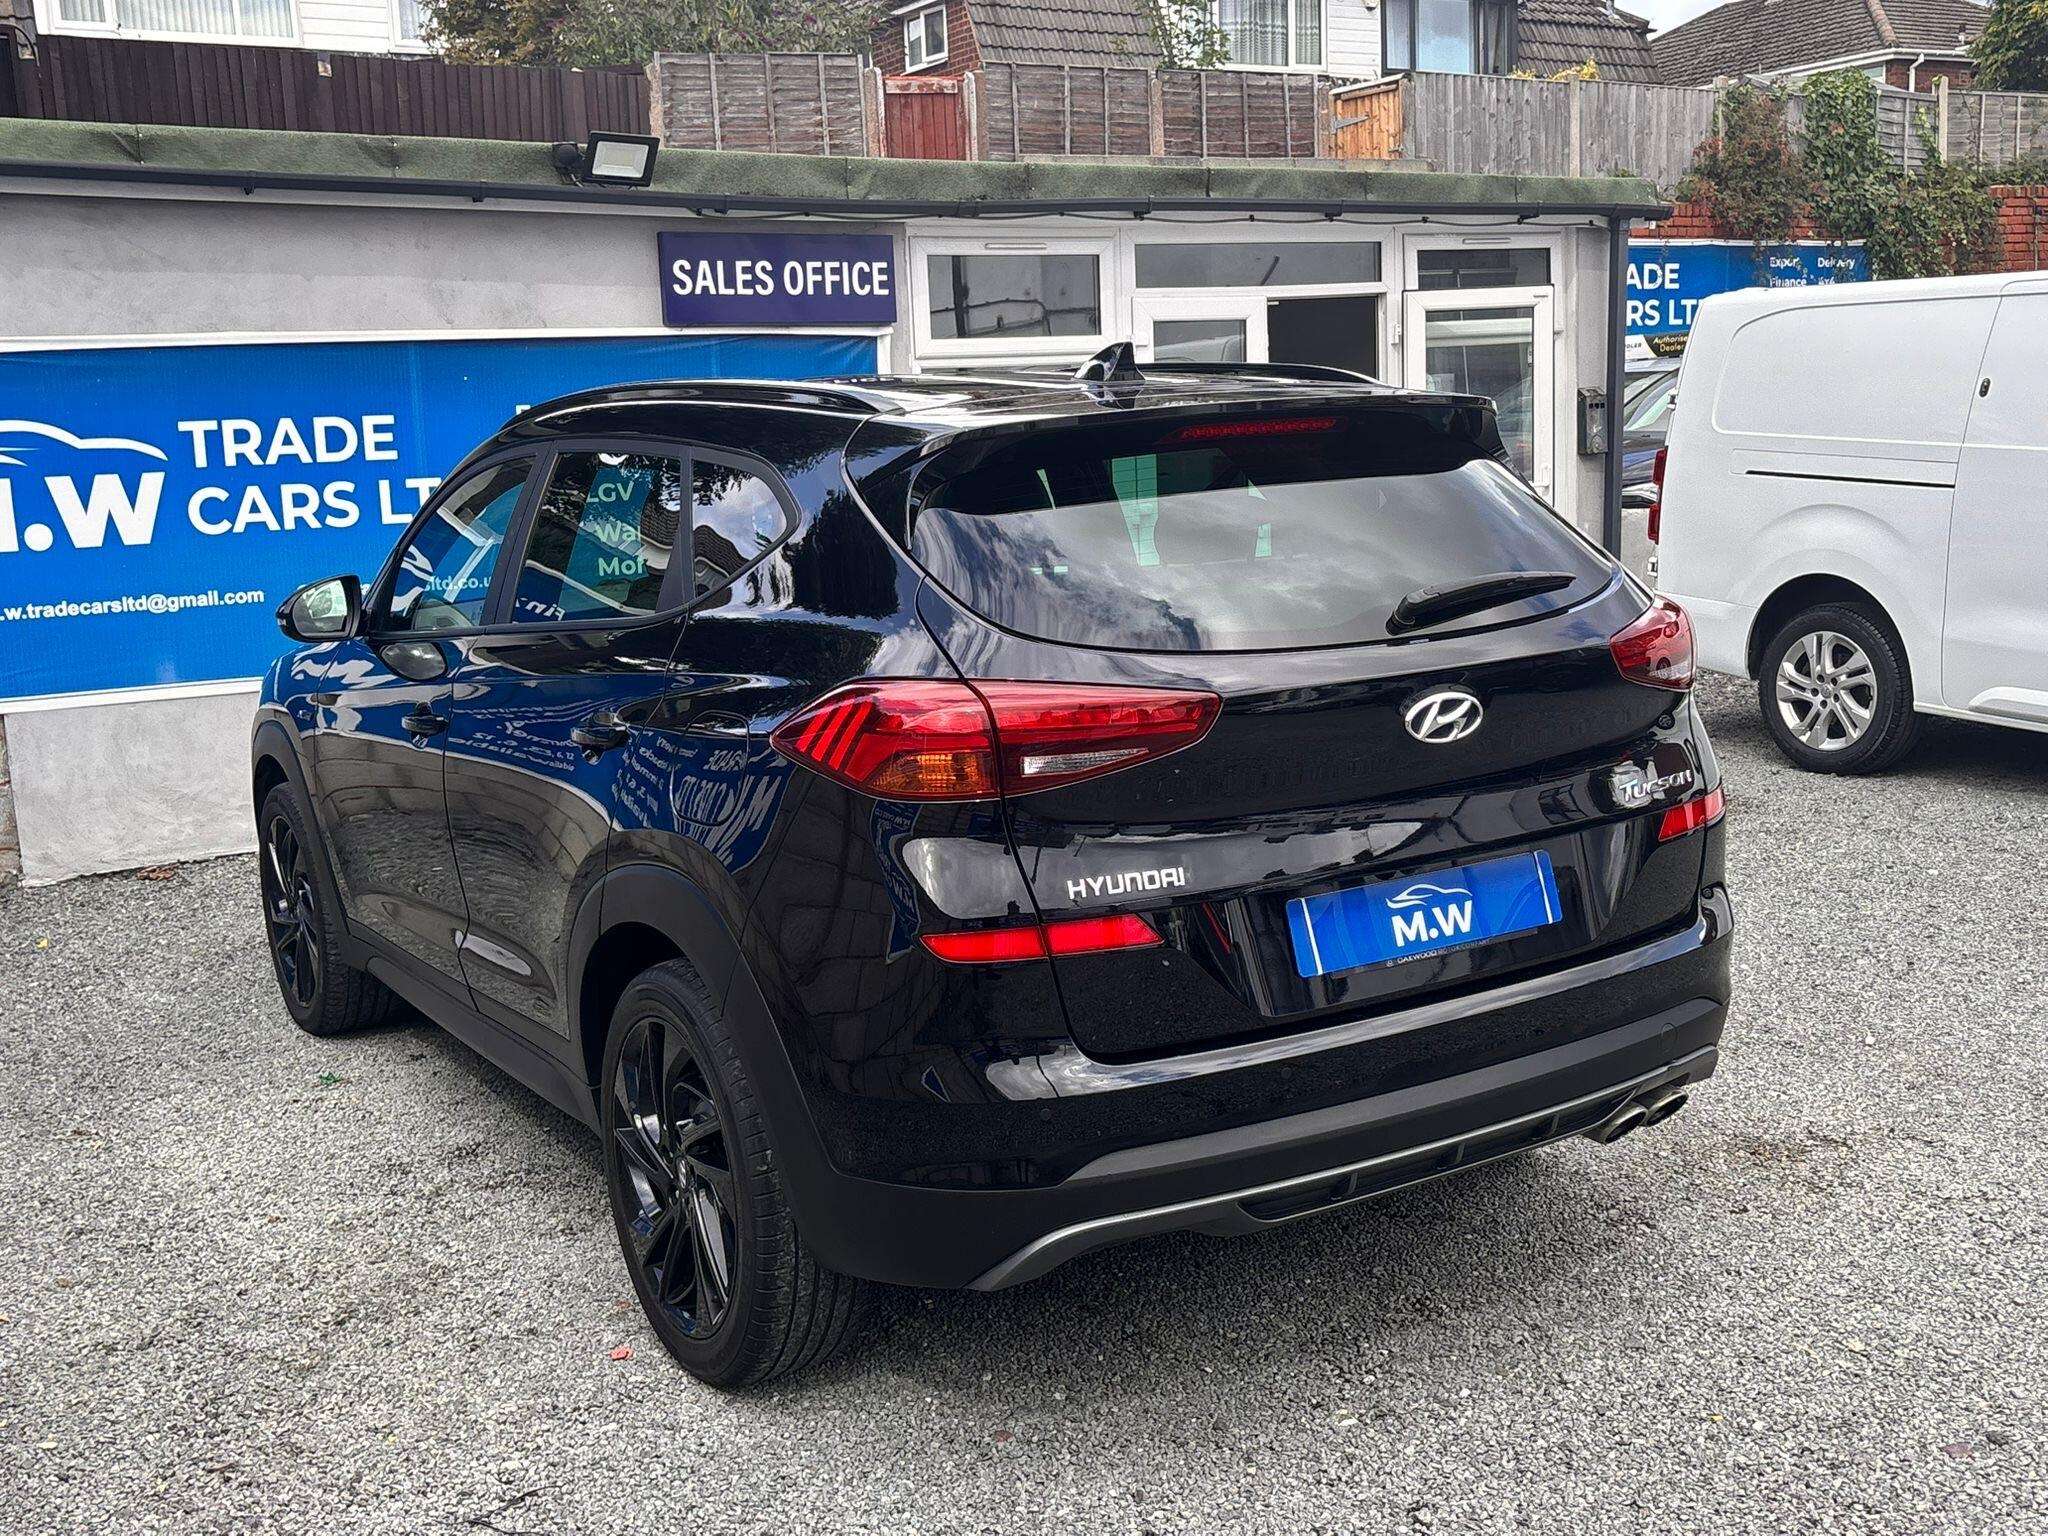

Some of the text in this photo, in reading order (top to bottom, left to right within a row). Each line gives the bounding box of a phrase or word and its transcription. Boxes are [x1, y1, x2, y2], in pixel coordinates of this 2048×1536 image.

[672, 259, 890, 296] SALES OFFICE
[1626, 299, 1660, 326] RS
[1659, 342, 1685, 352] Dealer
[177, 415, 399, 469] TRADE
[0, 471, 166, 552] .W
[187, 480, 360, 536] CARS
[1066, 866, 1186, 900] HYUNDAI
[1391, 899, 1473, 948] M.W
